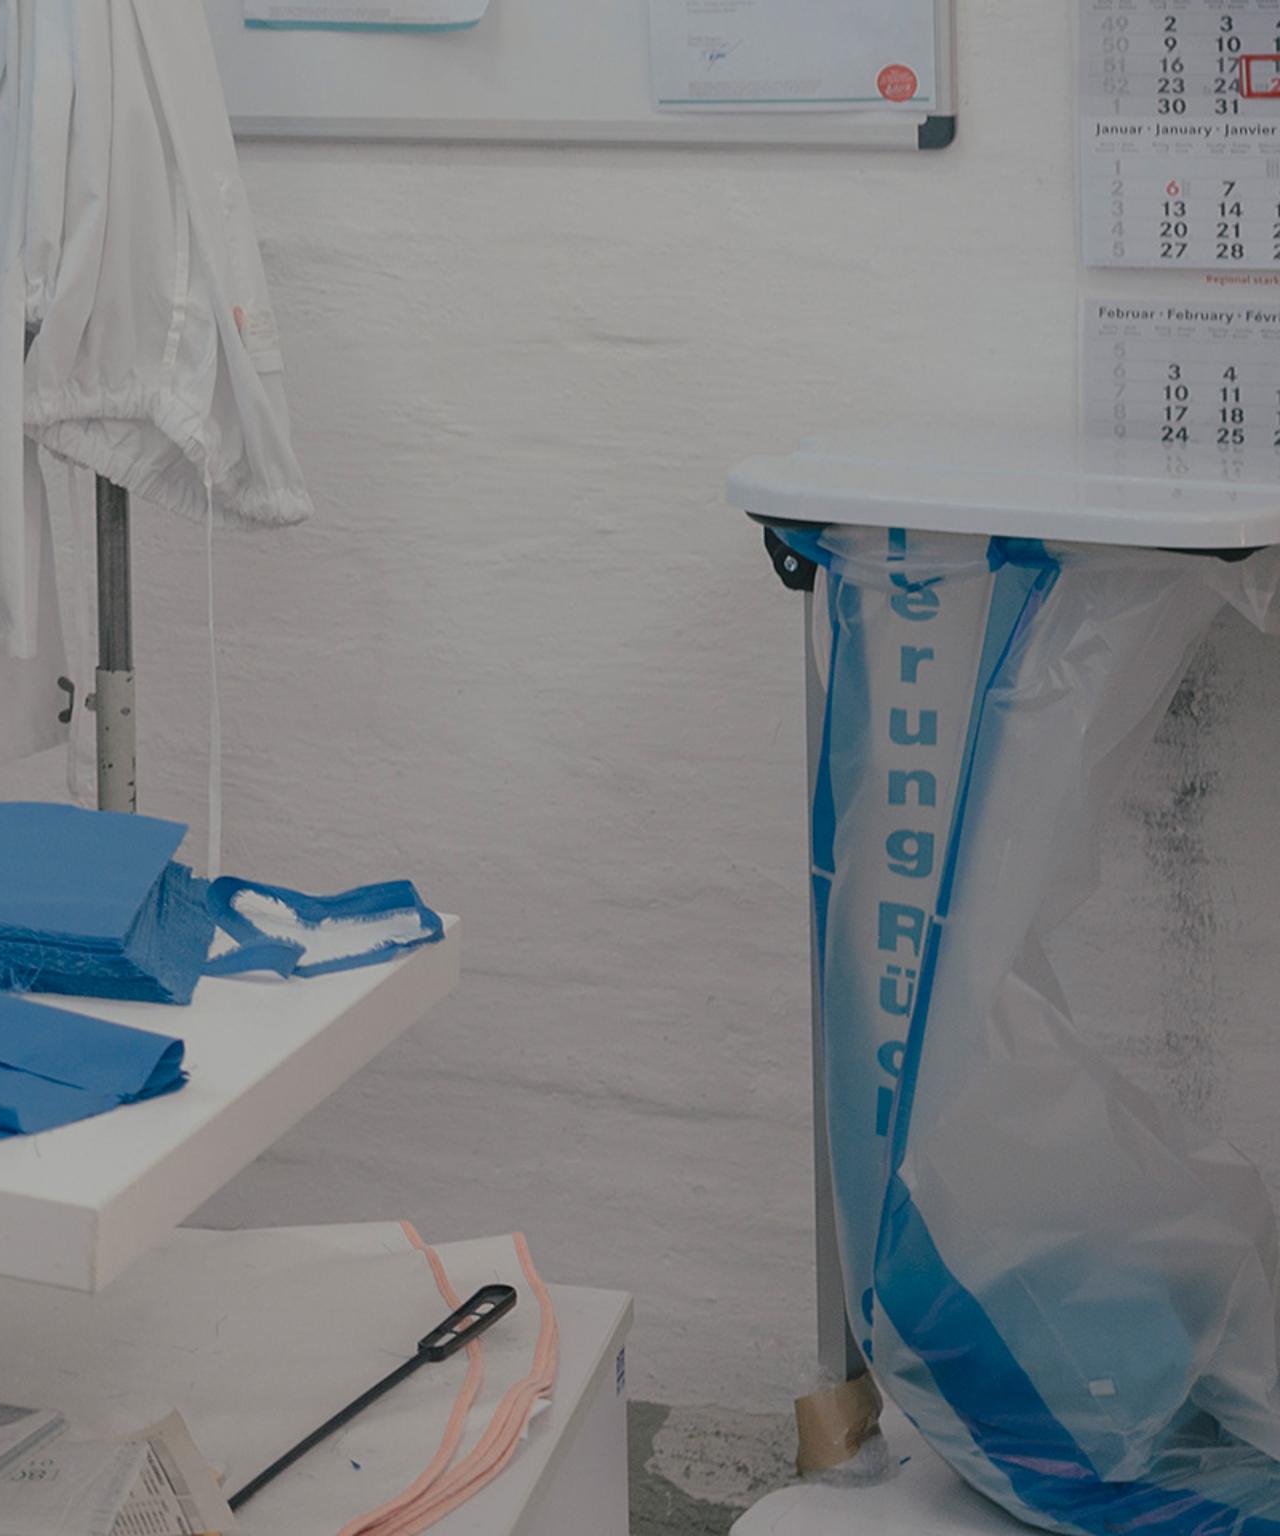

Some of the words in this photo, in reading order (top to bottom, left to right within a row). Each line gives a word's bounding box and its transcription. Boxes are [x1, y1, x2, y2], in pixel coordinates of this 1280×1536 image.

[1163, 15, 1177, 33] 2
[1220, 15, 1233, 33] 3
[1164, 36, 1177, 53] 9
[1215, 36, 1241, 53] 10
[1160, 57, 1185, 74] 16
[1216, 57, 1240, 73] 17
[1158, 78, 1185, 95] 23
[1214, 78, 1240, 95] 24
[1158, 99, 1186, 116] 30
[1214, 99, 1239, 116] 31
[1095, 123, 1143, 137] Januar
[1155, 123, 1212, 138] January
[1225, 123, 1277, 137] Janvier
[1166, 180, 1180, 197] 6
[1222, 180, 1236, 197] 7
[1162, 201, 1187, 218] 13
[1218, 201, 1243, 218] 14
[1160, 221, 1188, 239] 20
[1216, 221, 1241, 239] 21
[1160, 242, 1188, 259] 27
[1216, 243, 1245, 260] 28
[1098, 306, 1155, 320] Februar
[1167, 307, 1234, 325] February
[1168, 364, 1181, 381] 3
[1223, 366, 1237, 382] 4
[1163, 385, 1189, 402] 10
[1220, 386, 1240, 403] 11
[1164, 405, 1189, 422] 17
[1220, 407, 1244, 424] 18
[1161, 426, 1189, 443] 24
[1217, 427, 1245, 445] 25
